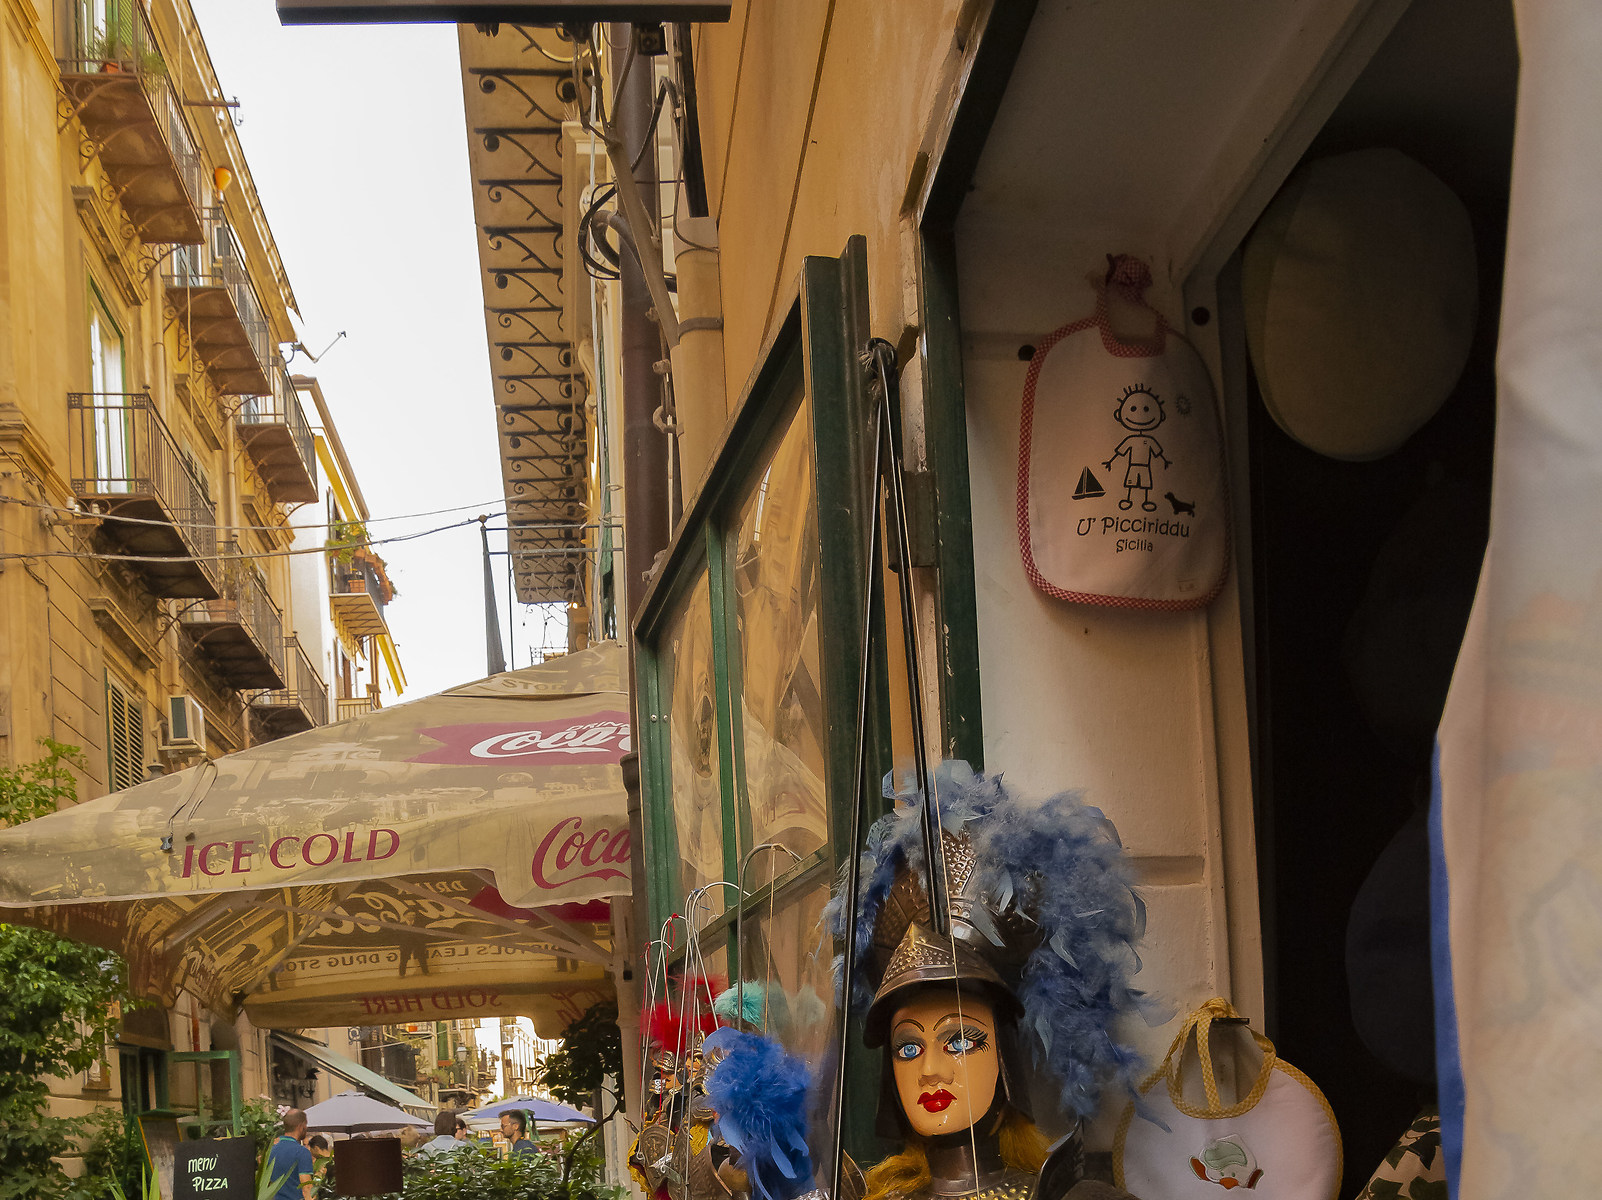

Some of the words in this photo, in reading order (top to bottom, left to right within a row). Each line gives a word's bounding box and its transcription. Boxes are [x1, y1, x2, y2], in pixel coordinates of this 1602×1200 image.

[1100, 516, 1190, 538] Picciriddu
[1116, 539, 1154, 553] Sicilia
[182, 841, 254, 879] ICE
[269, 829, 400, 870] COLD
[192, 1176, 228, 1192] PIZZA
